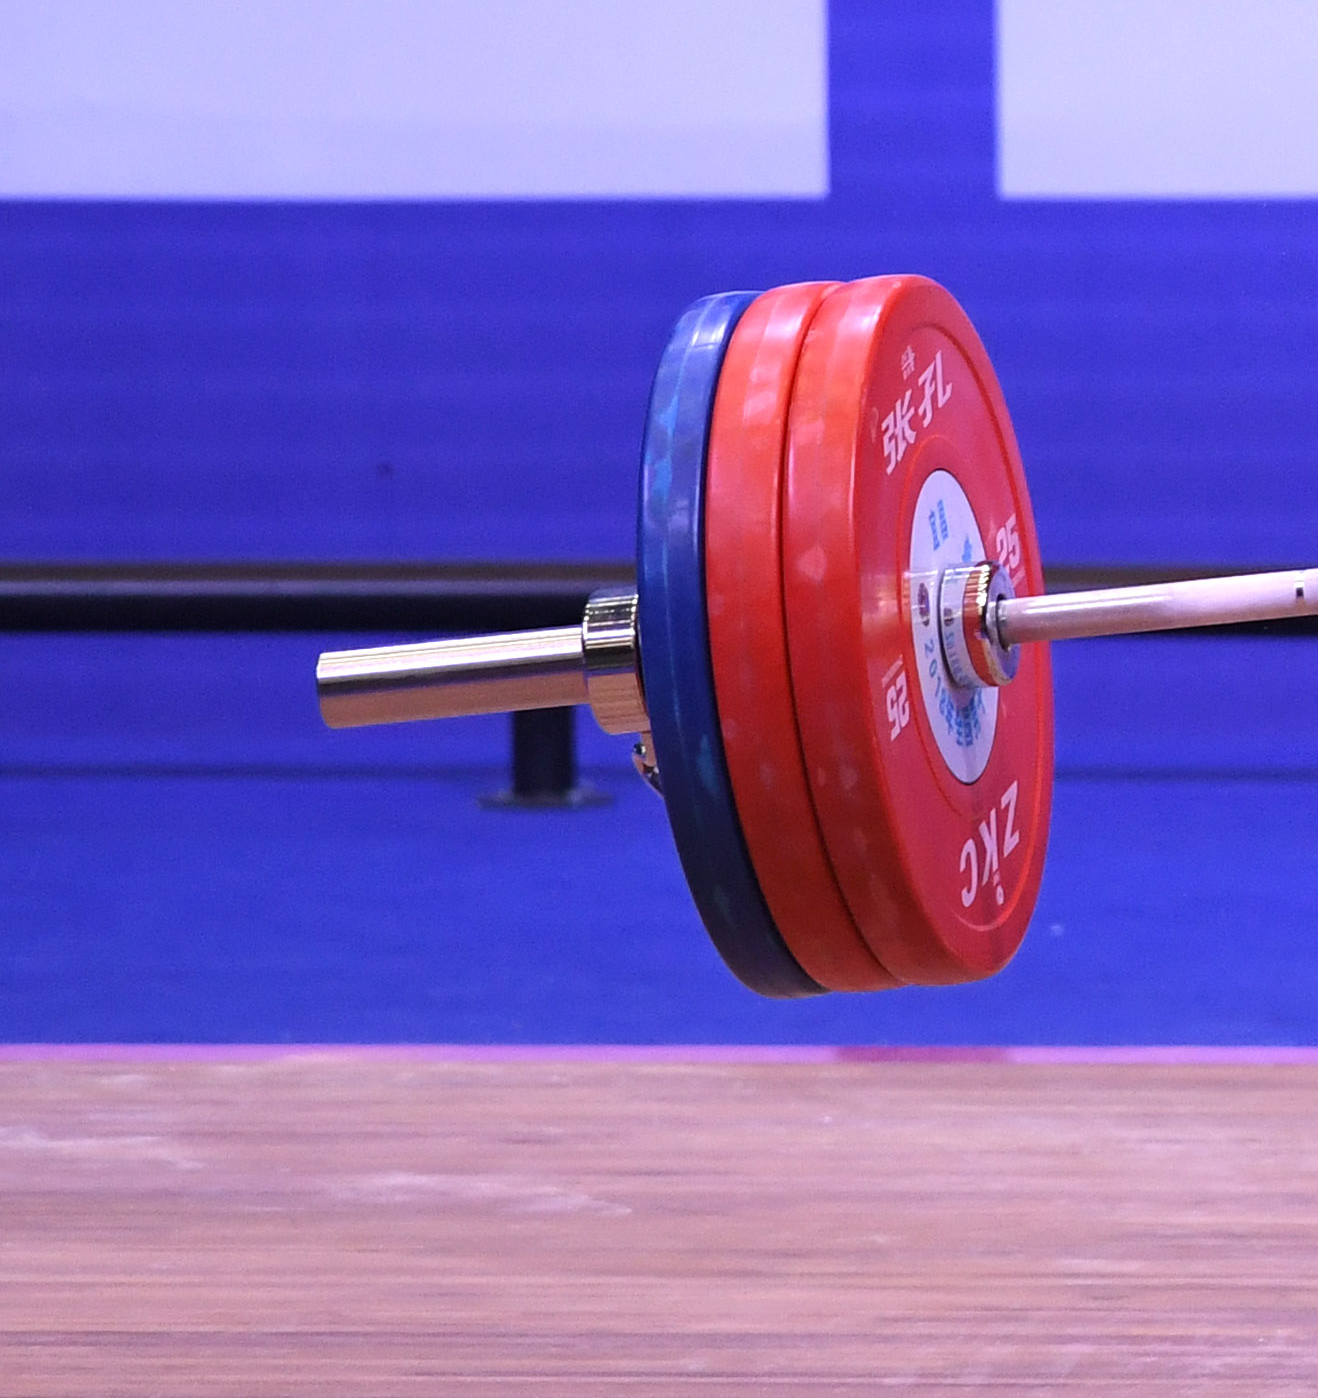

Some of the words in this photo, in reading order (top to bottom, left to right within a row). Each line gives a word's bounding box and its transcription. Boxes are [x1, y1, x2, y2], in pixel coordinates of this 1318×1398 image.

[881, 349, 953, 476] 张孔
[995, 512, 1021, 574] 25
[886, 670, 910, 742] 25
[959, 779, 1021, 908] ZKC
